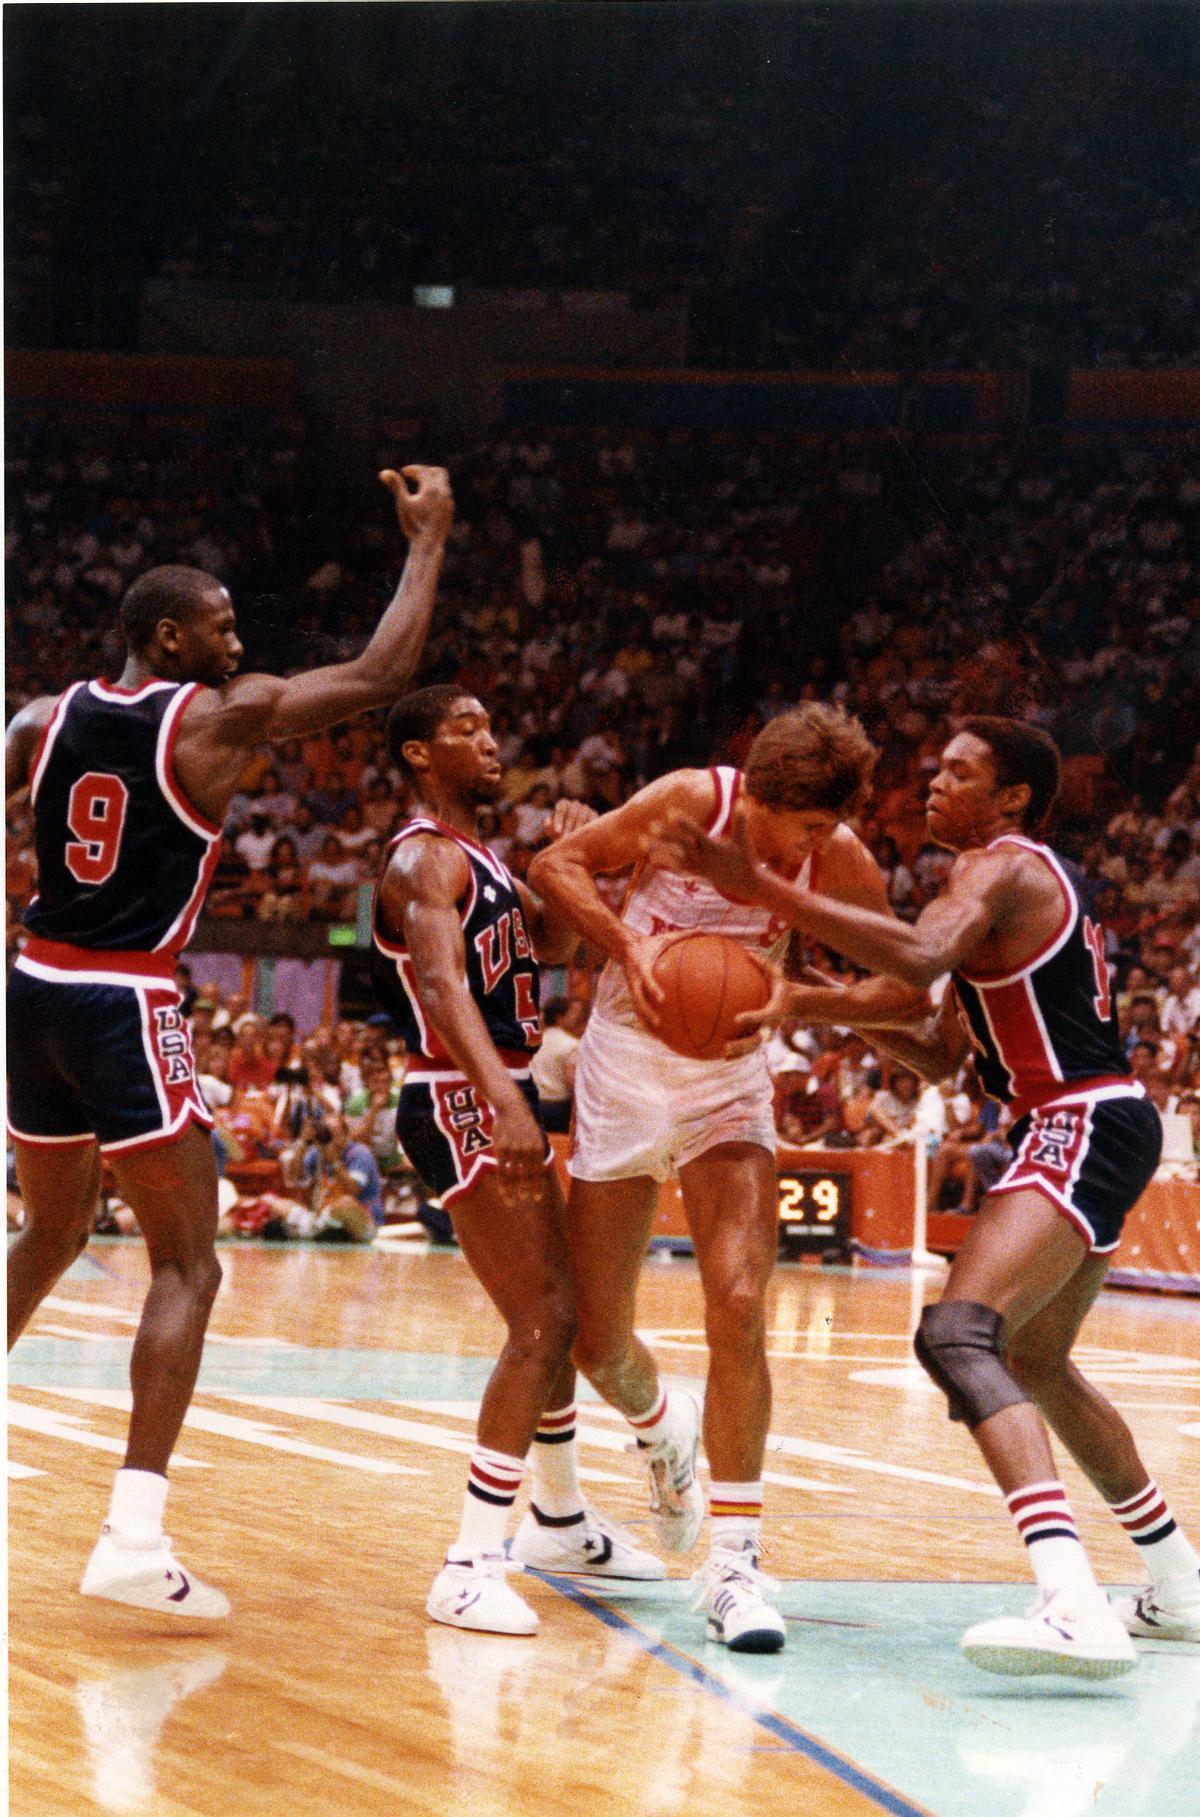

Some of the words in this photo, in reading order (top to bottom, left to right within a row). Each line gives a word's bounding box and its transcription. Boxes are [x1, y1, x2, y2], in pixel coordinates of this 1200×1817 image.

[65, 771, 129, 885] 9
[474, 908, 538, 995] US
[153, 1004, 192, 1085] USA
[513, 972, 542, 1047] 5
[444, 1087, 494, 1157] USA
[1030, 1111, 1079, 1172] USA
[779, 1179, 839, 1220] 29
